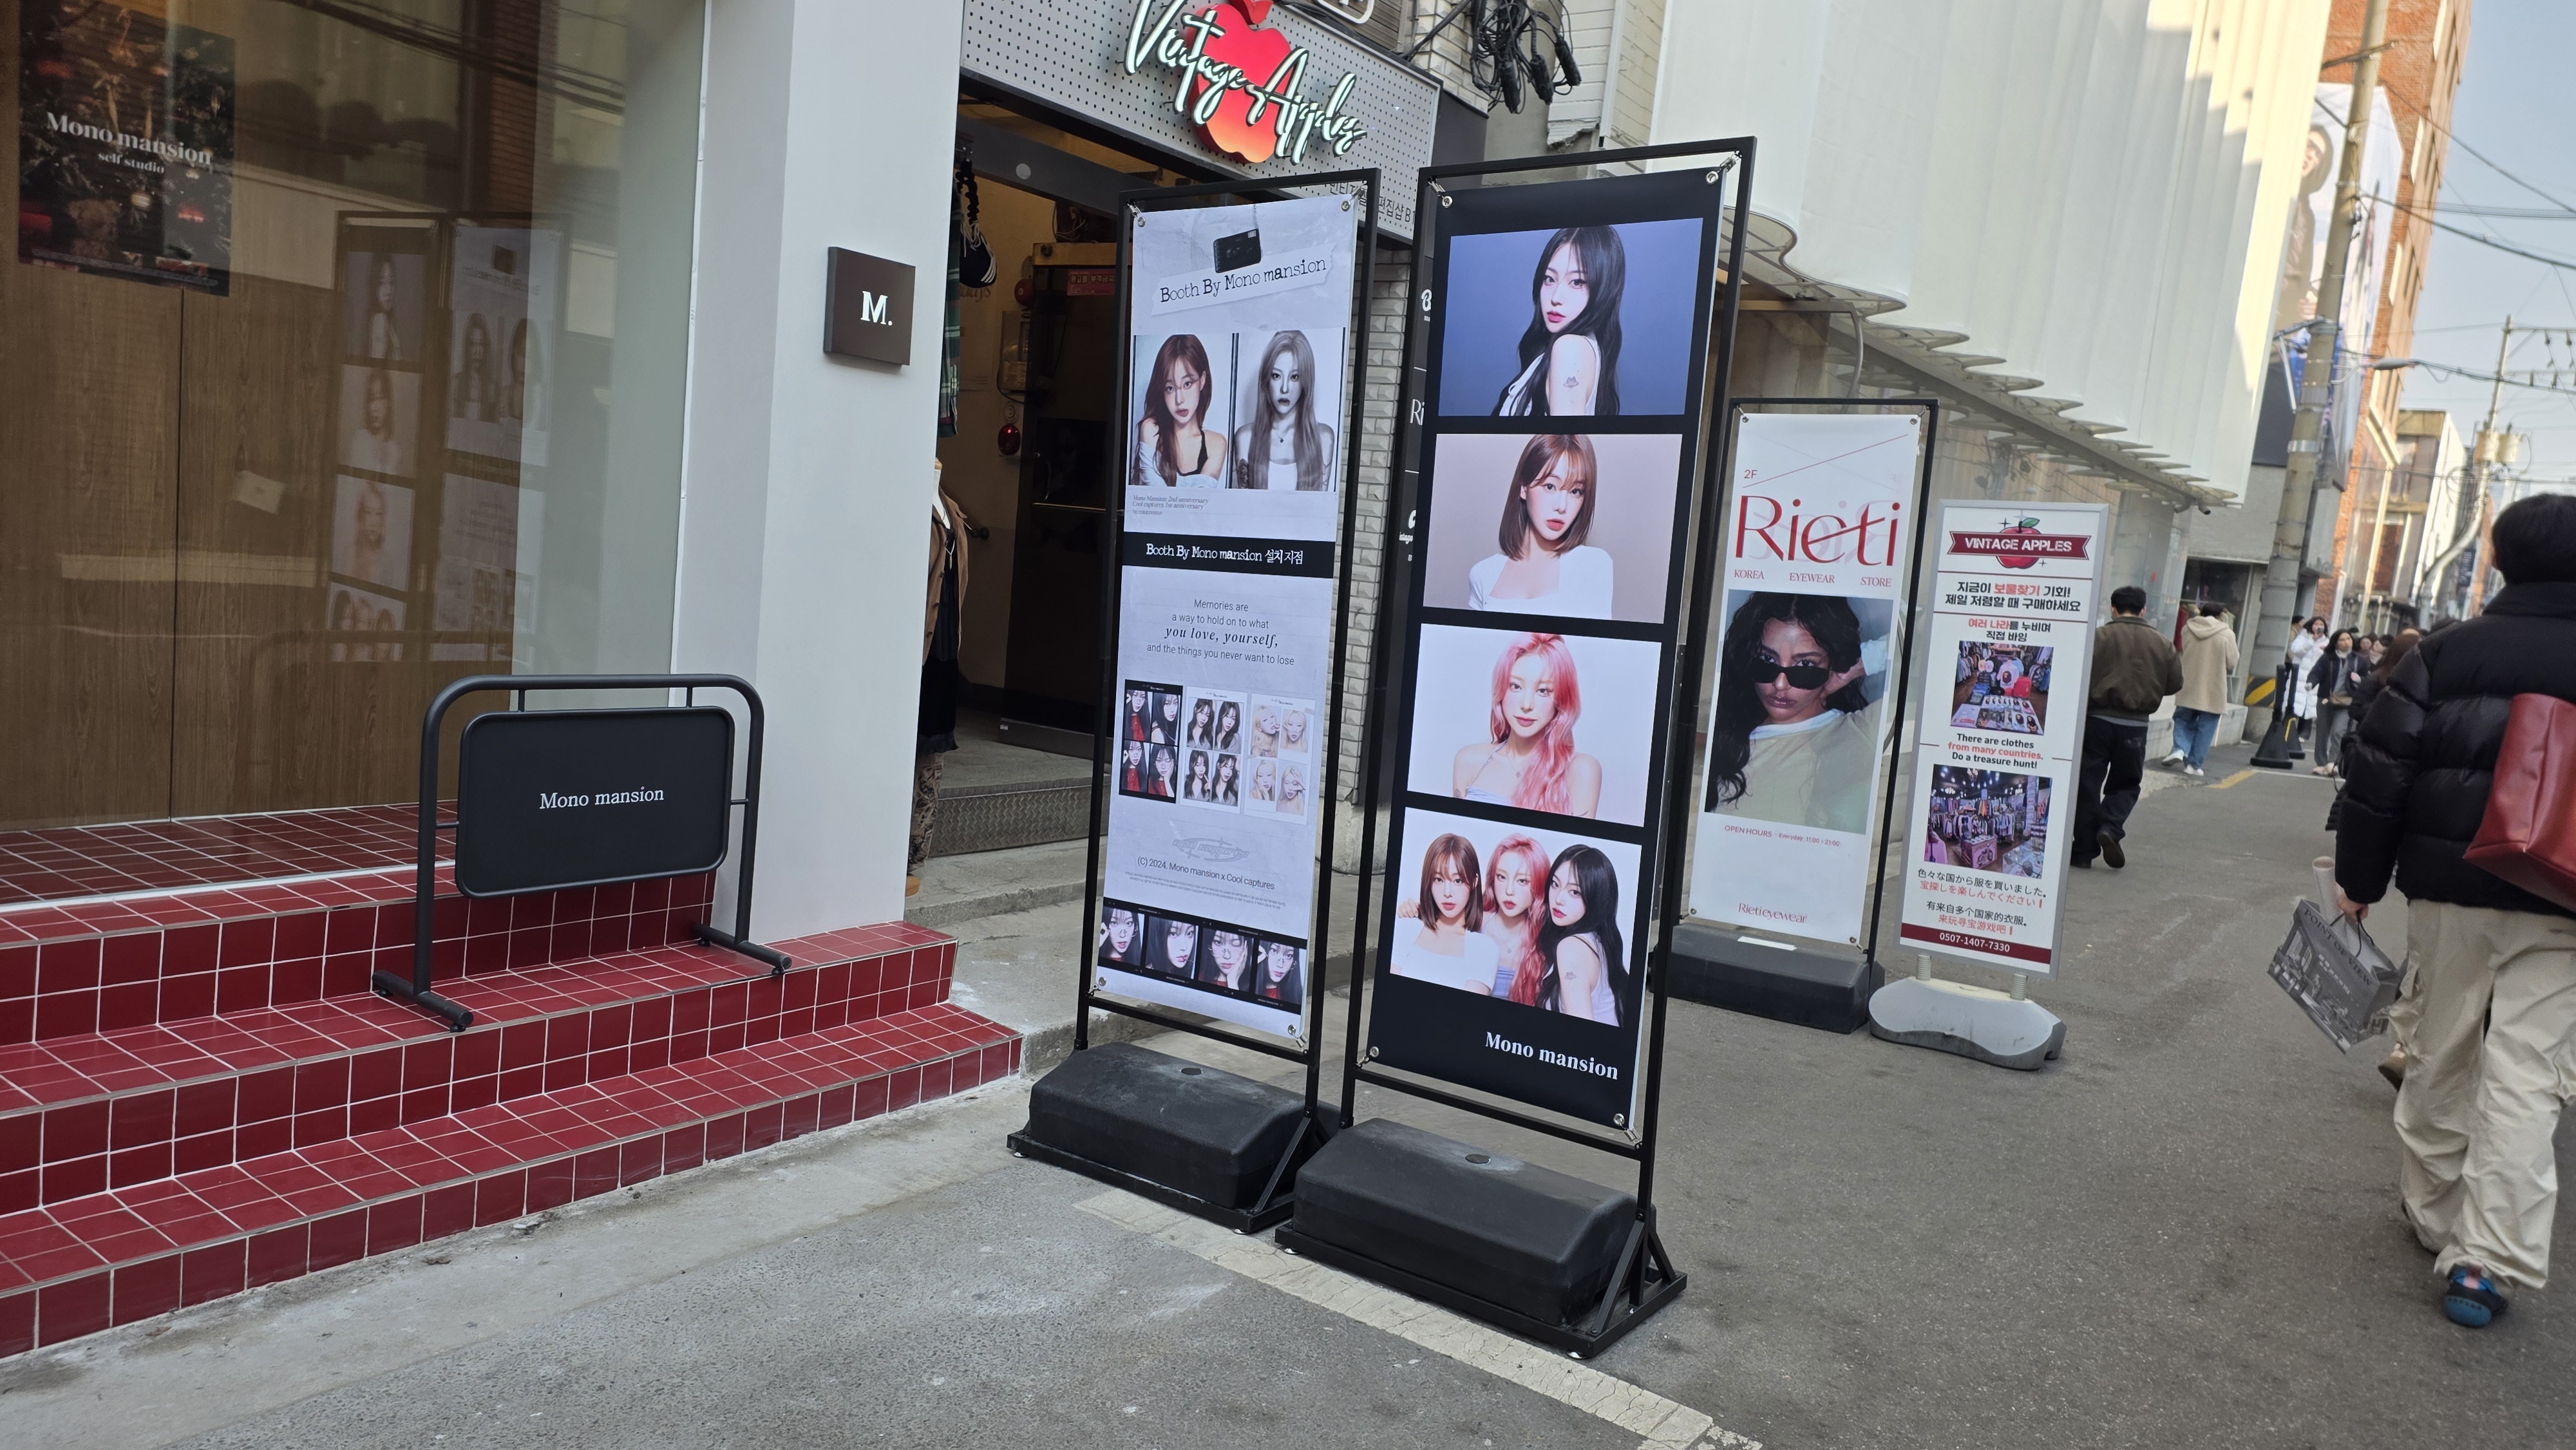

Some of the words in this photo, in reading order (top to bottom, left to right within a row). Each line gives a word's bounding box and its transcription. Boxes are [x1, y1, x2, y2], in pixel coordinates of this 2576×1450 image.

[1244, 46, 1367, 166] Apples
[47, 112, 113, 143] Mono
[117, 133, 211, 165] mansion
[97, 153, 122, 164] self
[124, 159, 164, 173] studio
[1160, 283, 1200, 302] Booth
[1203, 278, 1221, 296] By
[1224, 272, 1260, 290] Mono
[1264, 258, 1326, 282] mansion
[1744, 469, 1757, 478] 2F
[1736, 495, 1900, 566] Rieti
[1146, 543, 1175, 556] Booth
[1177, 545, 1189, 560] By
[1192, 546, 1217, 558] Mono
[1220, 549, 1262, 561] mansion
[1265, 549, 1283, 563] 설치
[1284, 551, 1303, 565] 지점
[1965, 538, 2019, 550] VINTAGE
[2022, 540, 2072, 552] APPLES
[1734, 569, 1765, 579] KOREA
[1789, 572, 1835, 583] EYEWEAR
[1861, 577, 1891, 587] STORE
[1957, 581, 1991, 593] 지금이
[1994, 583, 2040, 596] 보물찾기
[2043, 585, 2070, 597] 기회!
[1194, 599, 1233, 610] Memories
[1236, 603, 1249, 612] are
[1946, 594, 1967, 605] 제일
[1970, 596, 2005, 607] 저렴할
[2008, 598, 2019, 608] 때
[2022, 598, 2081, 612] 구매하세요
[1179, 614, 1195, 625] way
[1197, 615, 1205, 623] to
[1207, 616, 1224, 625] hold
[1227, 618, 1236, 626] on
[1238, 618, 1247, 627] to
[1249, 619, 1269, 629] what
[1969, 618, 1987, 628] 여러
[1990, 620, 2019, 630] 나라를
[2022, 622, 2051, 632] 누비며
[1164, 627, 1186, 639] you
[1191, 628, 1219, 643] love,
[1223, 633, 1278, 648] yourself,
[1986, 631, 2005, 641] 직접
[2008, 632, 2027, 642] 바잉
[1147, 643, 1161, 652] and
[1164, 645, 1175, 654] the
[1178, 646, 1202, 658] things
[1204, 650, 1218, 659] you
[1220, 650, 1242, 661] never
[1245, 652, 1264, 663] want
[1267, 654, 1274, 664] to
[1278, 655, 1294, 665] lose
[1957, 733, 1982, 743] There
[2001, 738, 2034, 749] clothes
[1948, 742, 1969, 751] from
[1971, 746, 1996, 755] many
[1998, 748, 2043, 760] countries.
[1973, 755, 2011, 766] treasure
[2013, 758, 2037, 769] hunt!
[539, 793, 589, 809] Mono
[594, 786, 664, 805] mansion
[1725, 825, 1745, 833] OPEN
[1746, 829, 1772, 837] HOURS
[1137, 856, 1148, 867] (C)
[1149, 859, 1168, 870] 2024.
[1170, 863, 1189, 873] Mono
[1190, 866, 1220, 879] mansion
[1227, 873, 1243, 884] Cool
[1244, 878, 1274, 890] captures
[2304, 909, 2334, 939] POINT
[1940, 932, 2010, 952] 0507-1407-7330
[1485, 1031, 1533, 1057] Mono
[1539, 1048, 1618, 1080] mansion
